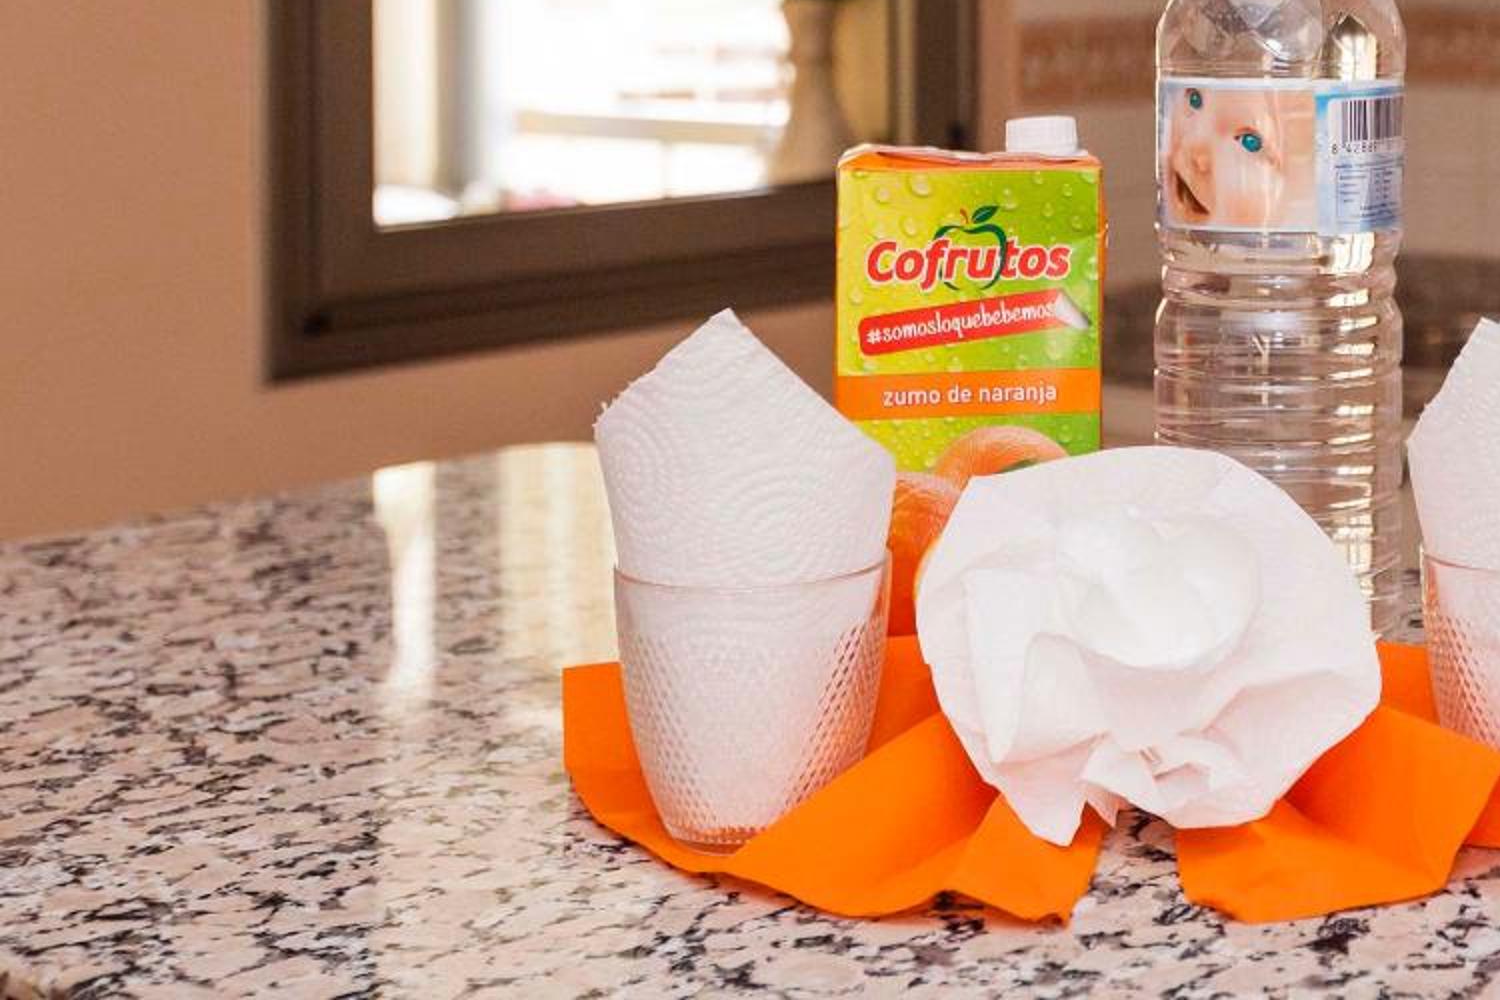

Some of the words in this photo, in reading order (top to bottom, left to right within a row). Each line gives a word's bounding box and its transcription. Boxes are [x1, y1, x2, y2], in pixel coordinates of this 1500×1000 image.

[867, 237, 1071, 291] Cofrutos
[866, 299, 1058, 344] #somosloquebebemos
[884, 389, 941, 406] zumo
[948, 384, 972, 403] de
[979, 382, 1057, 405] naranja
